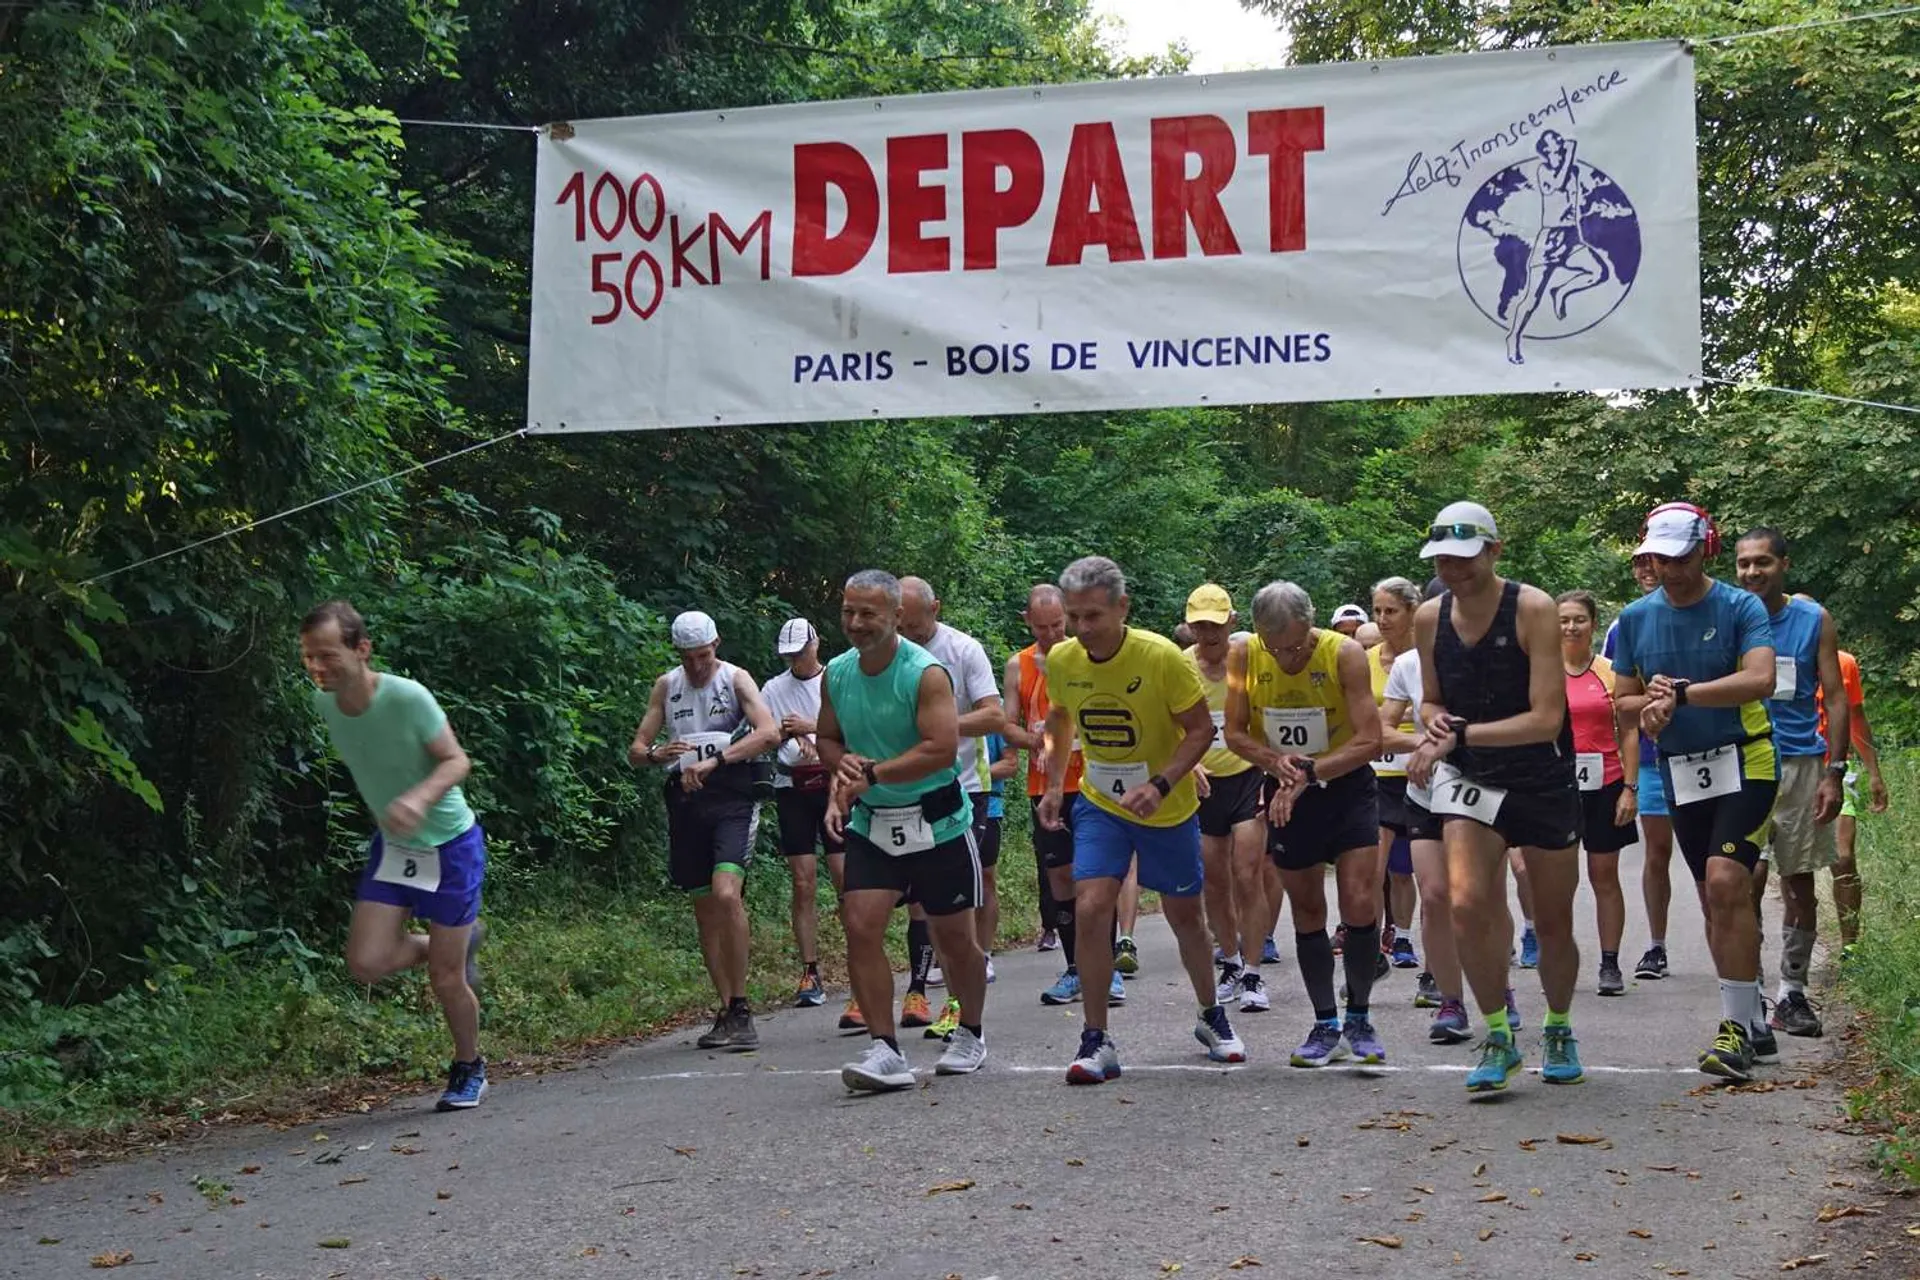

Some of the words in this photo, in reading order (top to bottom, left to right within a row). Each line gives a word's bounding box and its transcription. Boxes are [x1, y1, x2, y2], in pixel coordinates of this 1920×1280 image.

[791, 106, 1326, 277] DEPART
[556, 171, 665, 243] 100
[671, 210, 772, 288] KM
[591, 250, 664, 325] 50
[794, 351, 894, 383] PARIS
[946, 343, 1031, 377] BOIS
[1051, 342, 1097, 371] DE
[1127, 333, 1331, 369] VINCENNES
[1278, 725, 1308, 746] 20
[1112, 779, 1125, 797] 4
[1696, 767, 1712, 789] 3
[1450, 783, 1481, 807] 10
[891, 826, 906, 846] 5
[403, 859, 417, 878] 8
